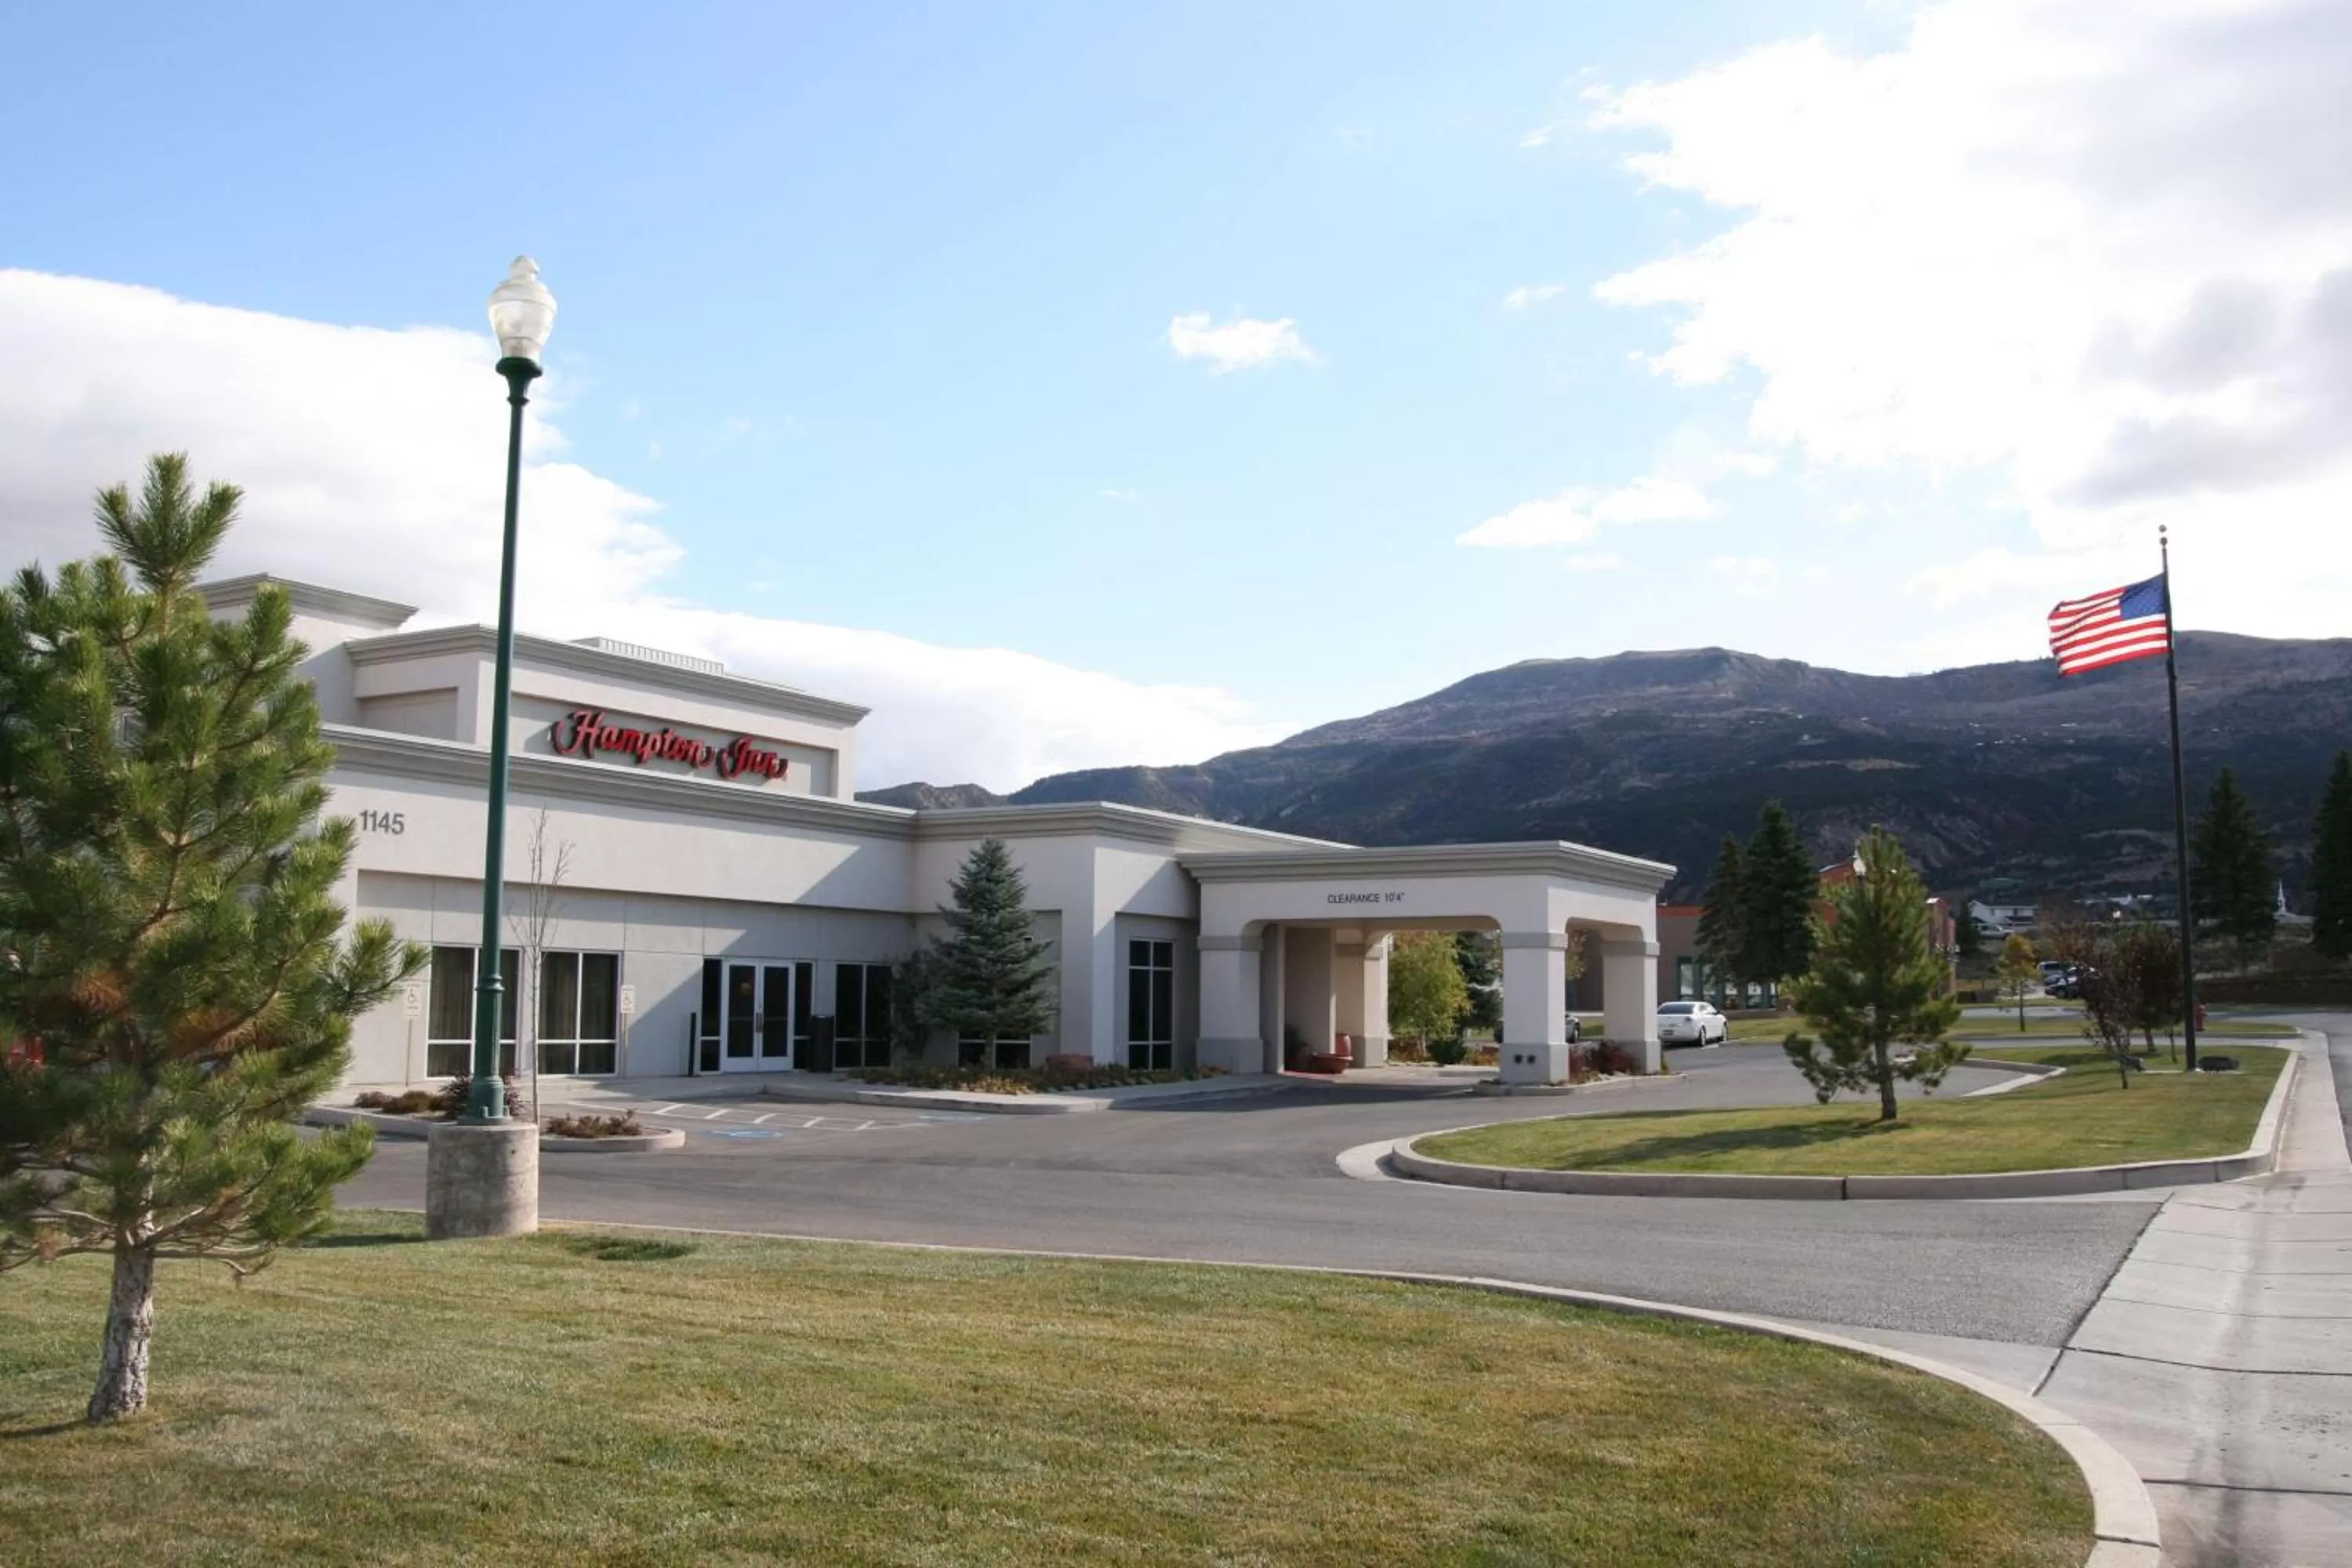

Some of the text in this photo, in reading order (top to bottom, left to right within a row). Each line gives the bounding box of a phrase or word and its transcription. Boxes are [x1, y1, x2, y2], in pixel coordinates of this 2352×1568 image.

[551, 707, 789, 779] Hampton Inn
[359, 809, 405, 835] 1145
[1327, 893, 1380, 903] CLEARANCE
